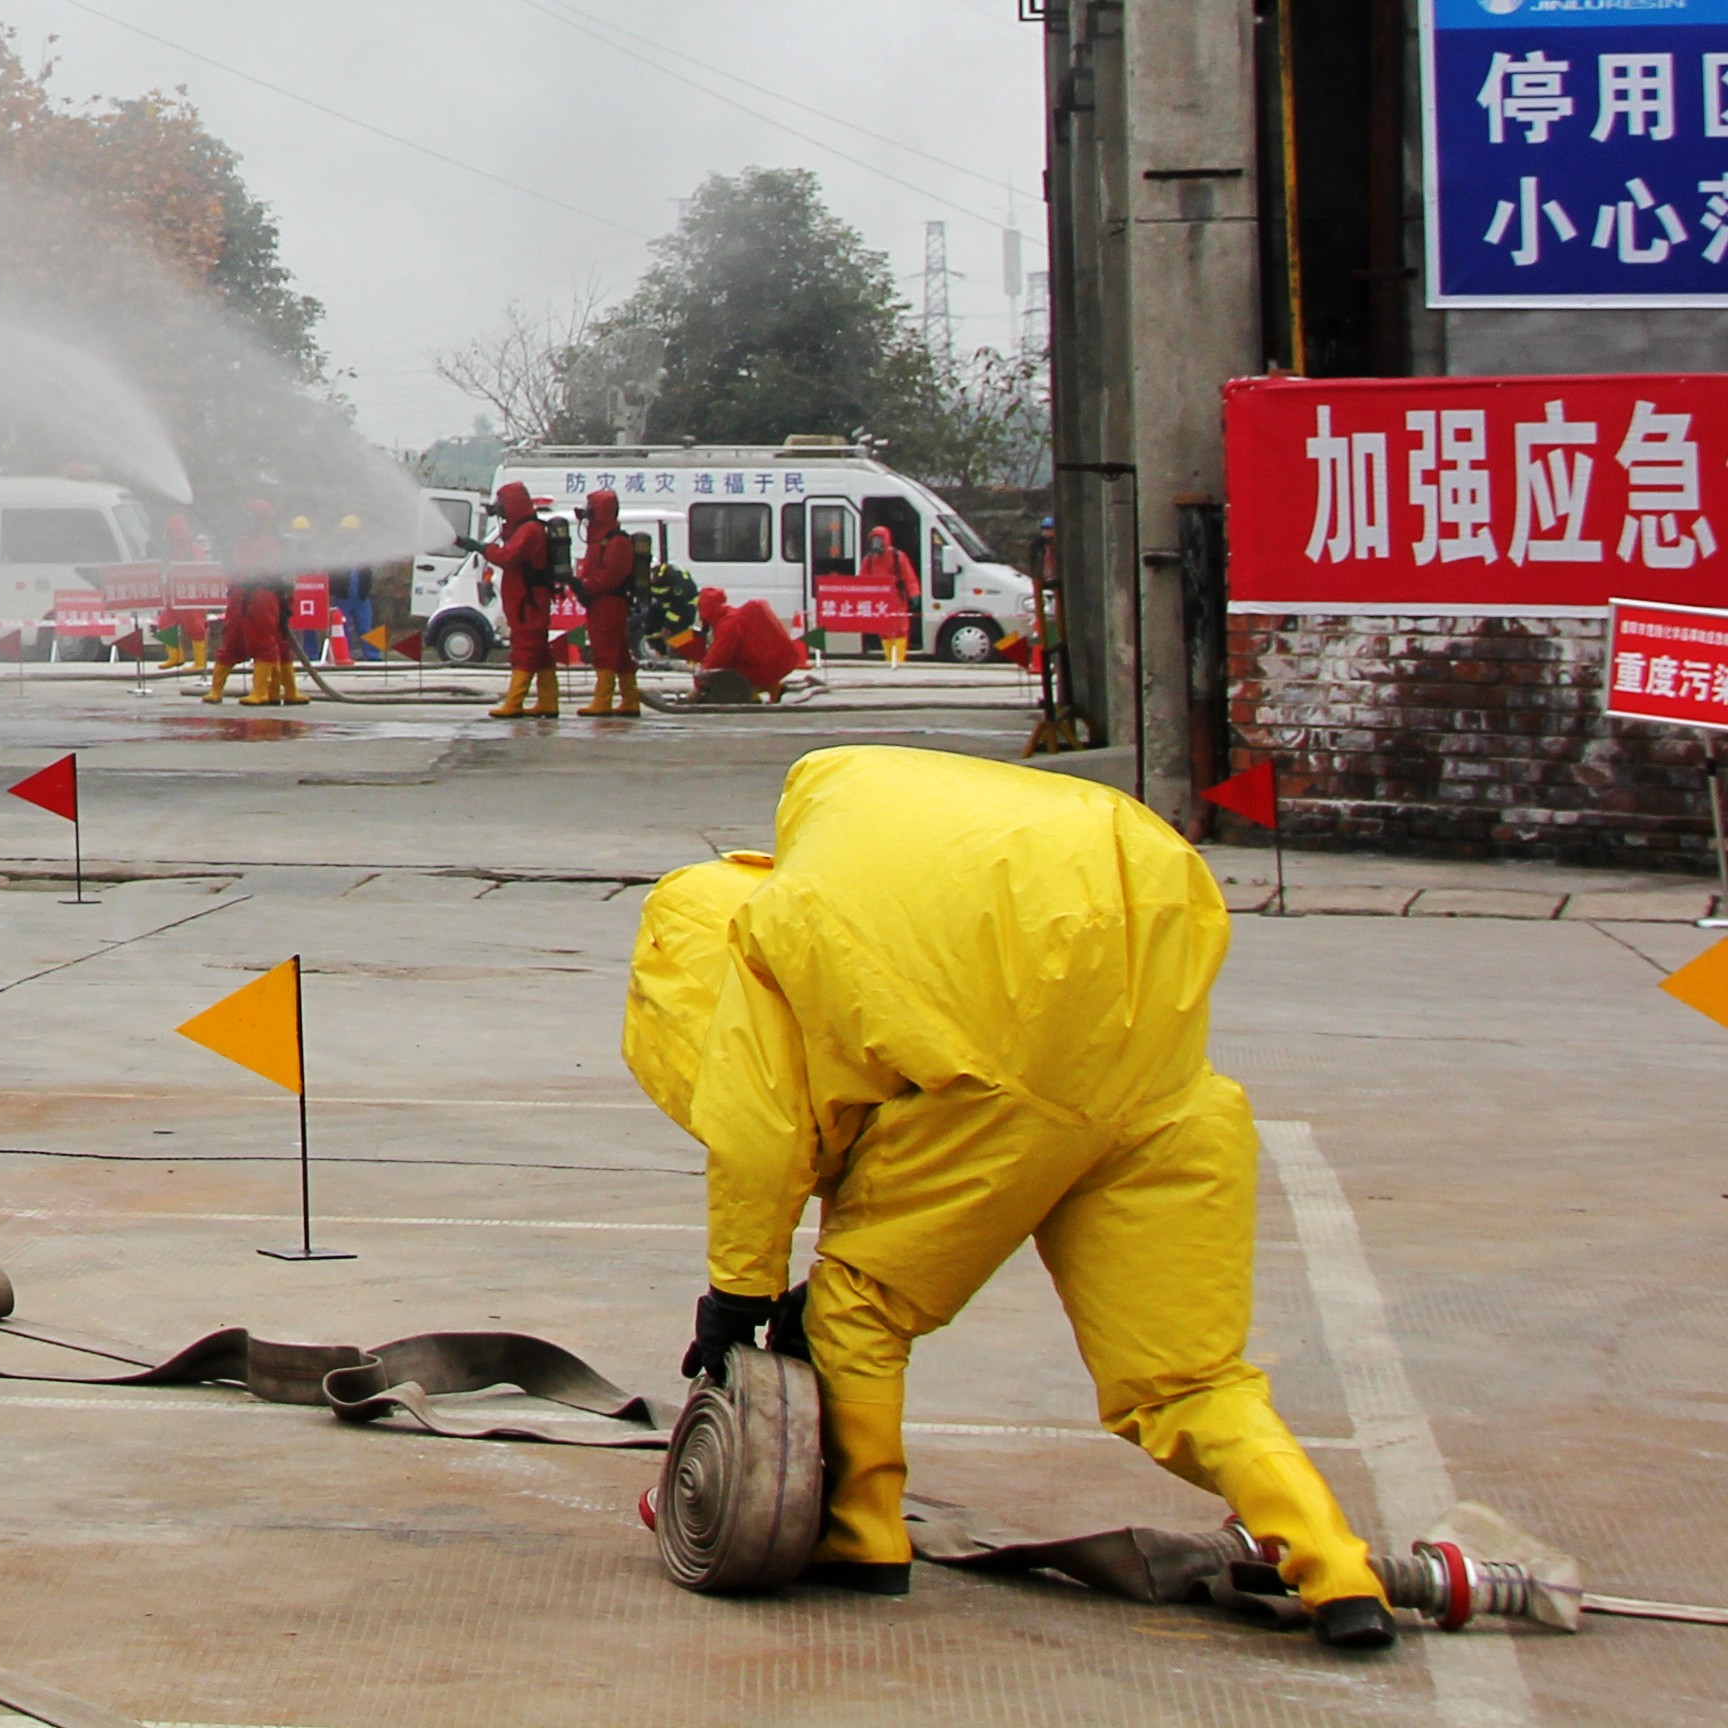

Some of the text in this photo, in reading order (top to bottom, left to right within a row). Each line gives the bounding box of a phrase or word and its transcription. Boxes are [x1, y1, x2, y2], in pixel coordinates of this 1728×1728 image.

[565, 472, 806, 494] 防灾减灾 造福于民
[1304, 399, 1718, 569] 加强应急
